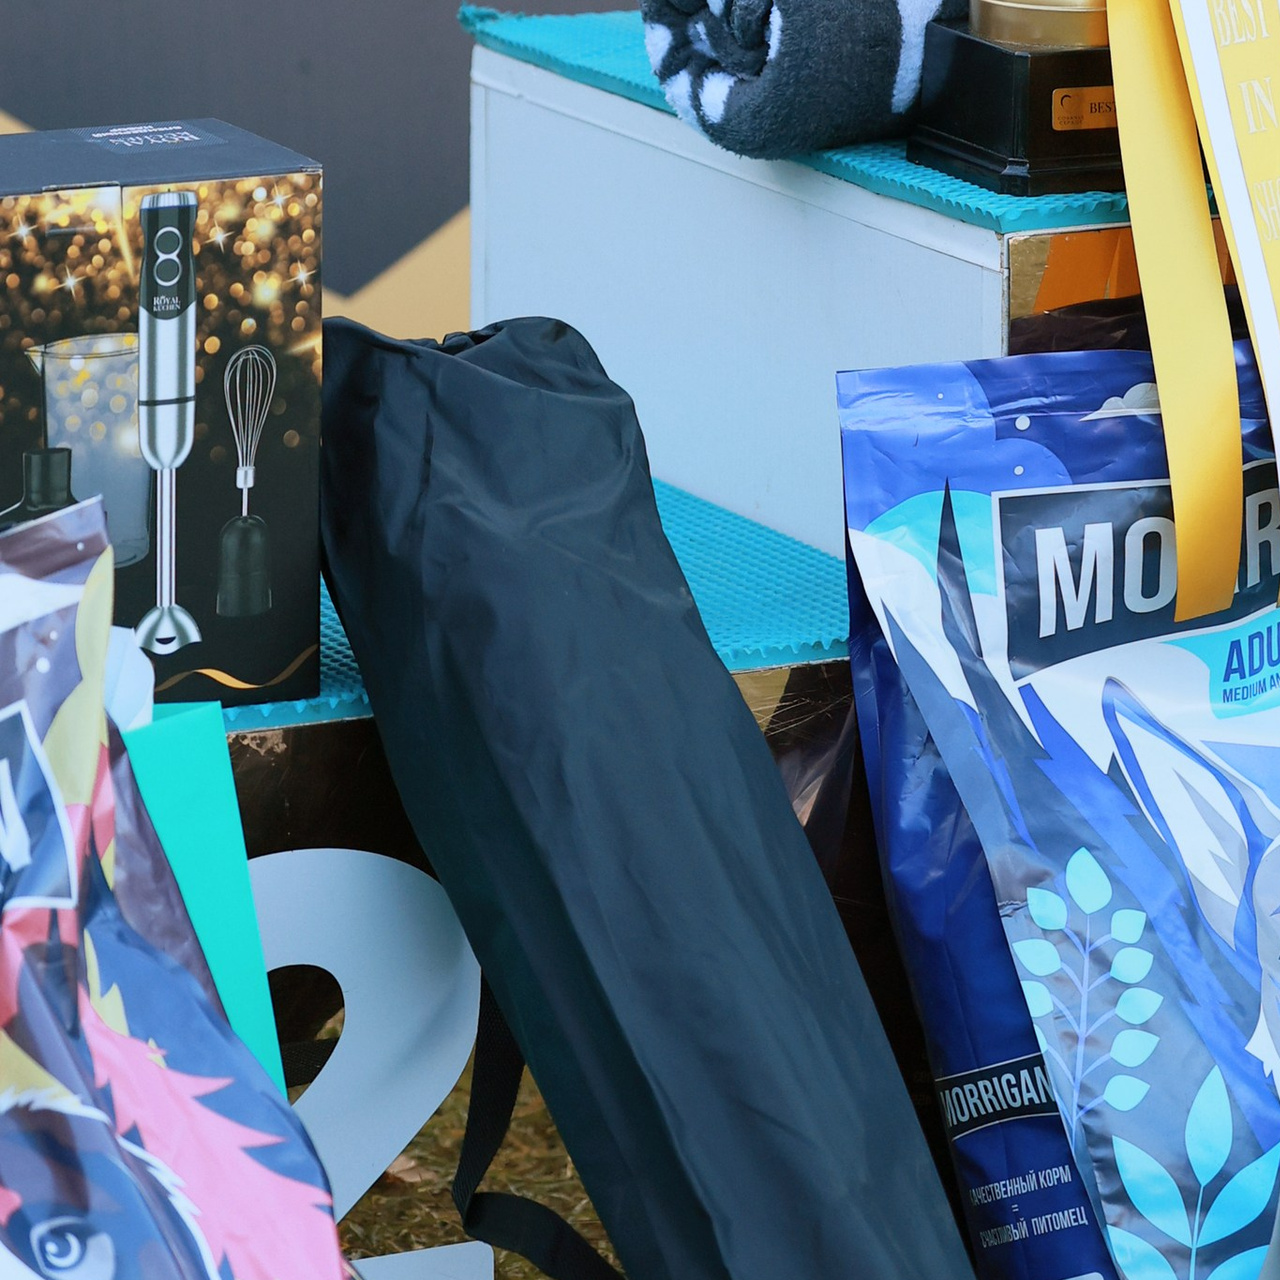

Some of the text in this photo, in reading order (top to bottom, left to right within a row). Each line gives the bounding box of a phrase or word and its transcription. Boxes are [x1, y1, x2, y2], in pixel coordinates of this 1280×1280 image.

[1238, 76, 1279, 134] IN
[1222, 677, 1268, 703] MEDIUM
[1038, 1164, 1072, 1189] КОРМ
[1031, 1206, 1089, 1236] ПИТОМЕЦ
